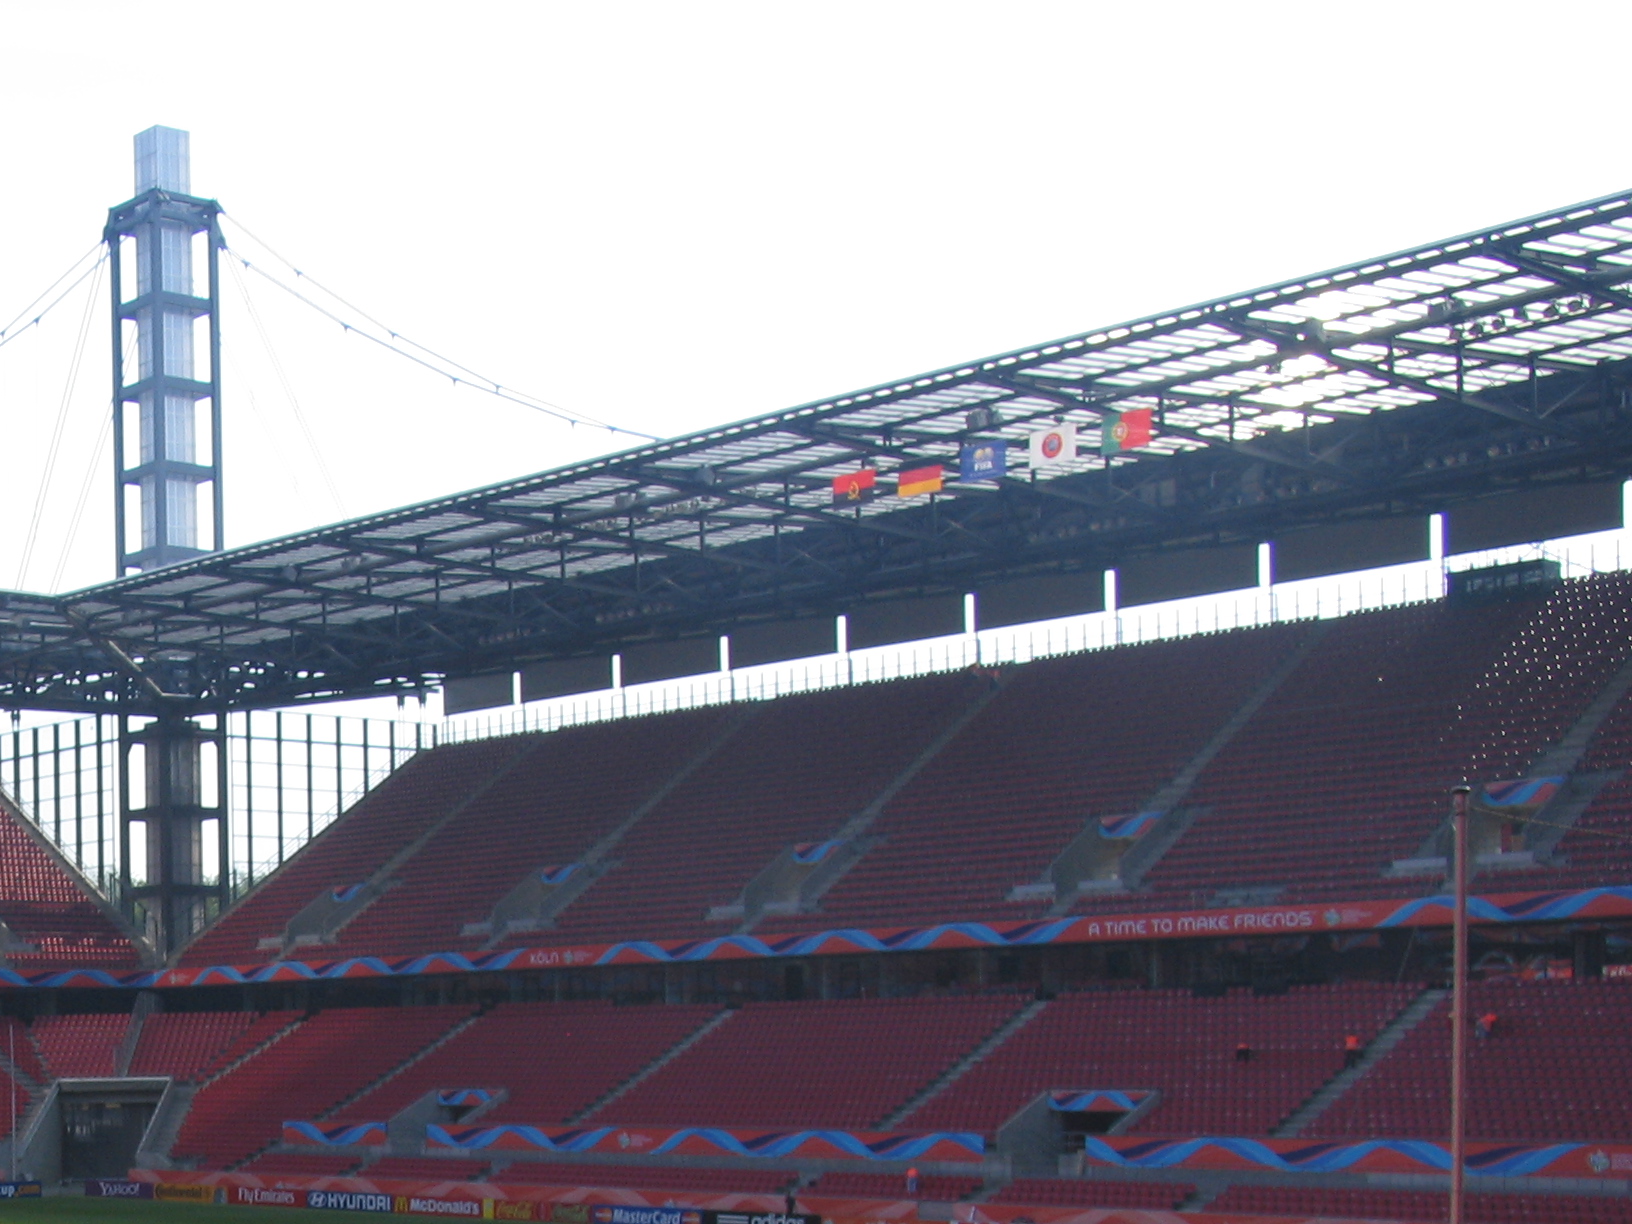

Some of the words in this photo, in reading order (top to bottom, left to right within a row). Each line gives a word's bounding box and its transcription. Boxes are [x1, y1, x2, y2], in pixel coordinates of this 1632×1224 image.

[1088, 921, 1101, 937] A
[1104, 919, 1147, 935] TIME
[1151, 917, 1173, 934] TO
[1177, 914, 1230, 932] MAKE
[1234, 910, 1313, 929] FRIENDS
[237, 1186, 253, 1205] Fly
[254, 1188, 296, 1204] Emirates
[327, 1192, 392, 1211] HYUNDAI
[409, 1197, 480, 1216] McDonald's
